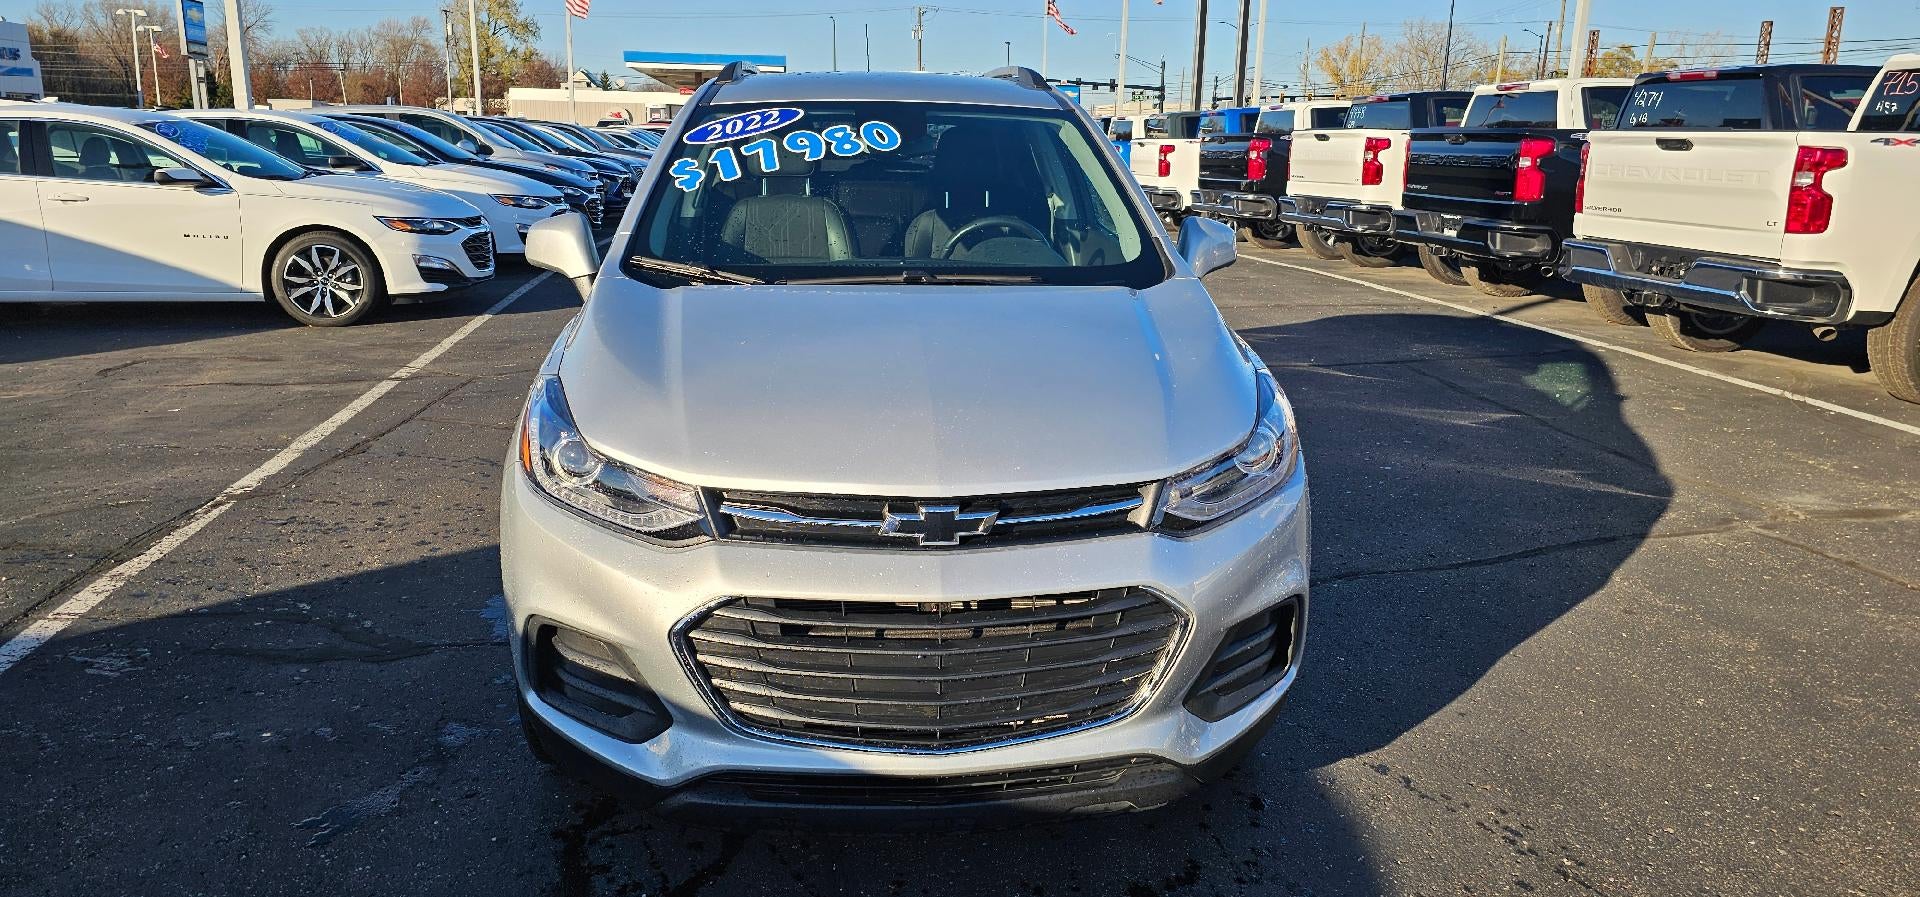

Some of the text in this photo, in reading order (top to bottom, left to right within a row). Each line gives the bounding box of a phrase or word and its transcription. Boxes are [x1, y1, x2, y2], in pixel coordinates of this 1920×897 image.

[1883, 71, 1920, 96] 715
[1634, 88, 1664, 109] 4274
[706, 110, 781, 141] 2022
[669, 121, 902, 192] $17980
[1591, 163, 1771, 187] CHEVROLET
